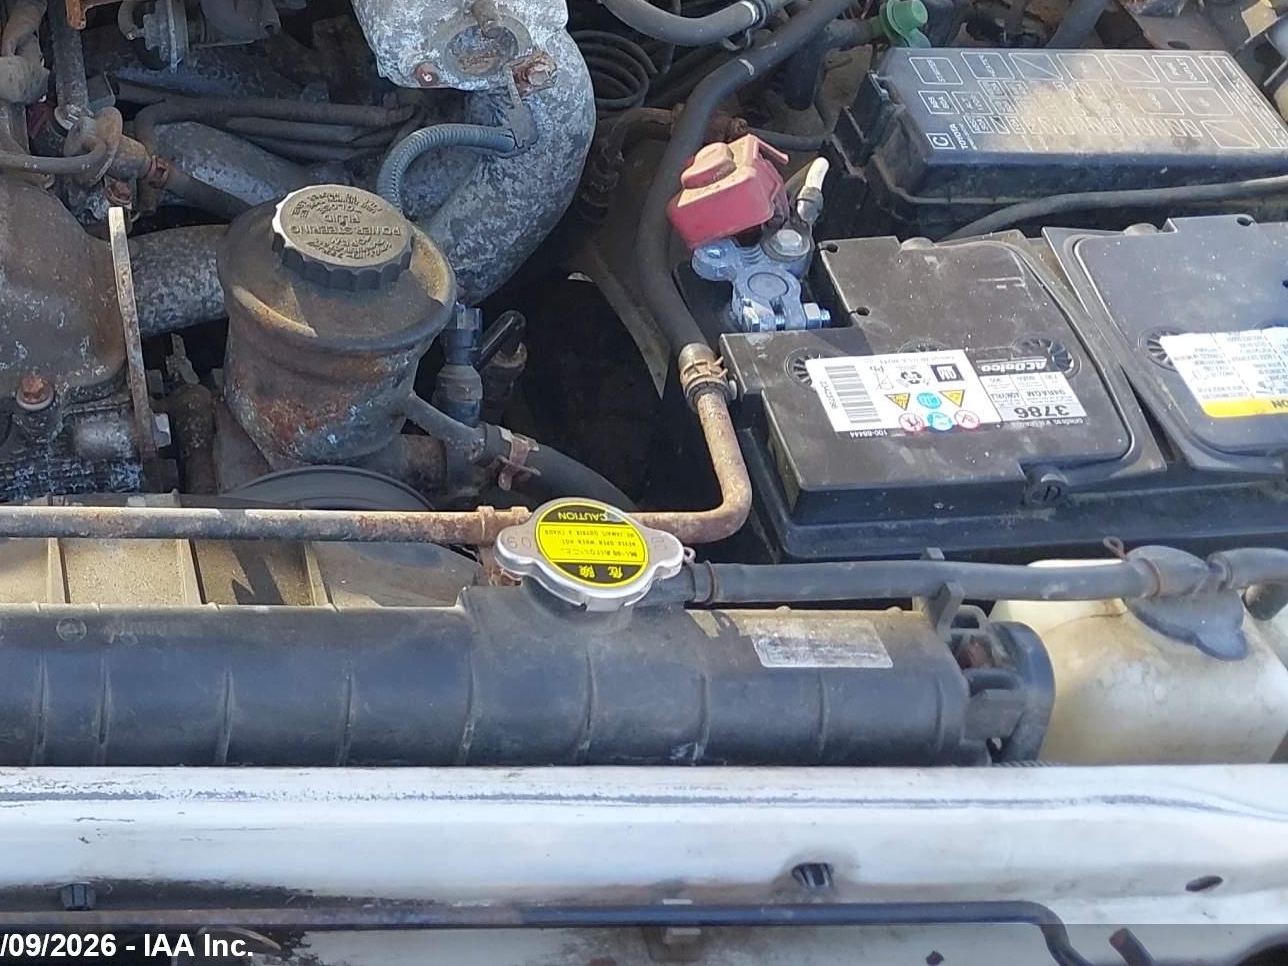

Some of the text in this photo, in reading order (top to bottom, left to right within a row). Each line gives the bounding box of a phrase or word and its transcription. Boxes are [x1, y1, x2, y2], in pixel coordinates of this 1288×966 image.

[949, 123, 969, 150] TOYOTA
[980, 359, 1047, 373] ACDelco
[1013, 404, 1070, 419] 3786
[557, 511, 609, 523] CAUTION
